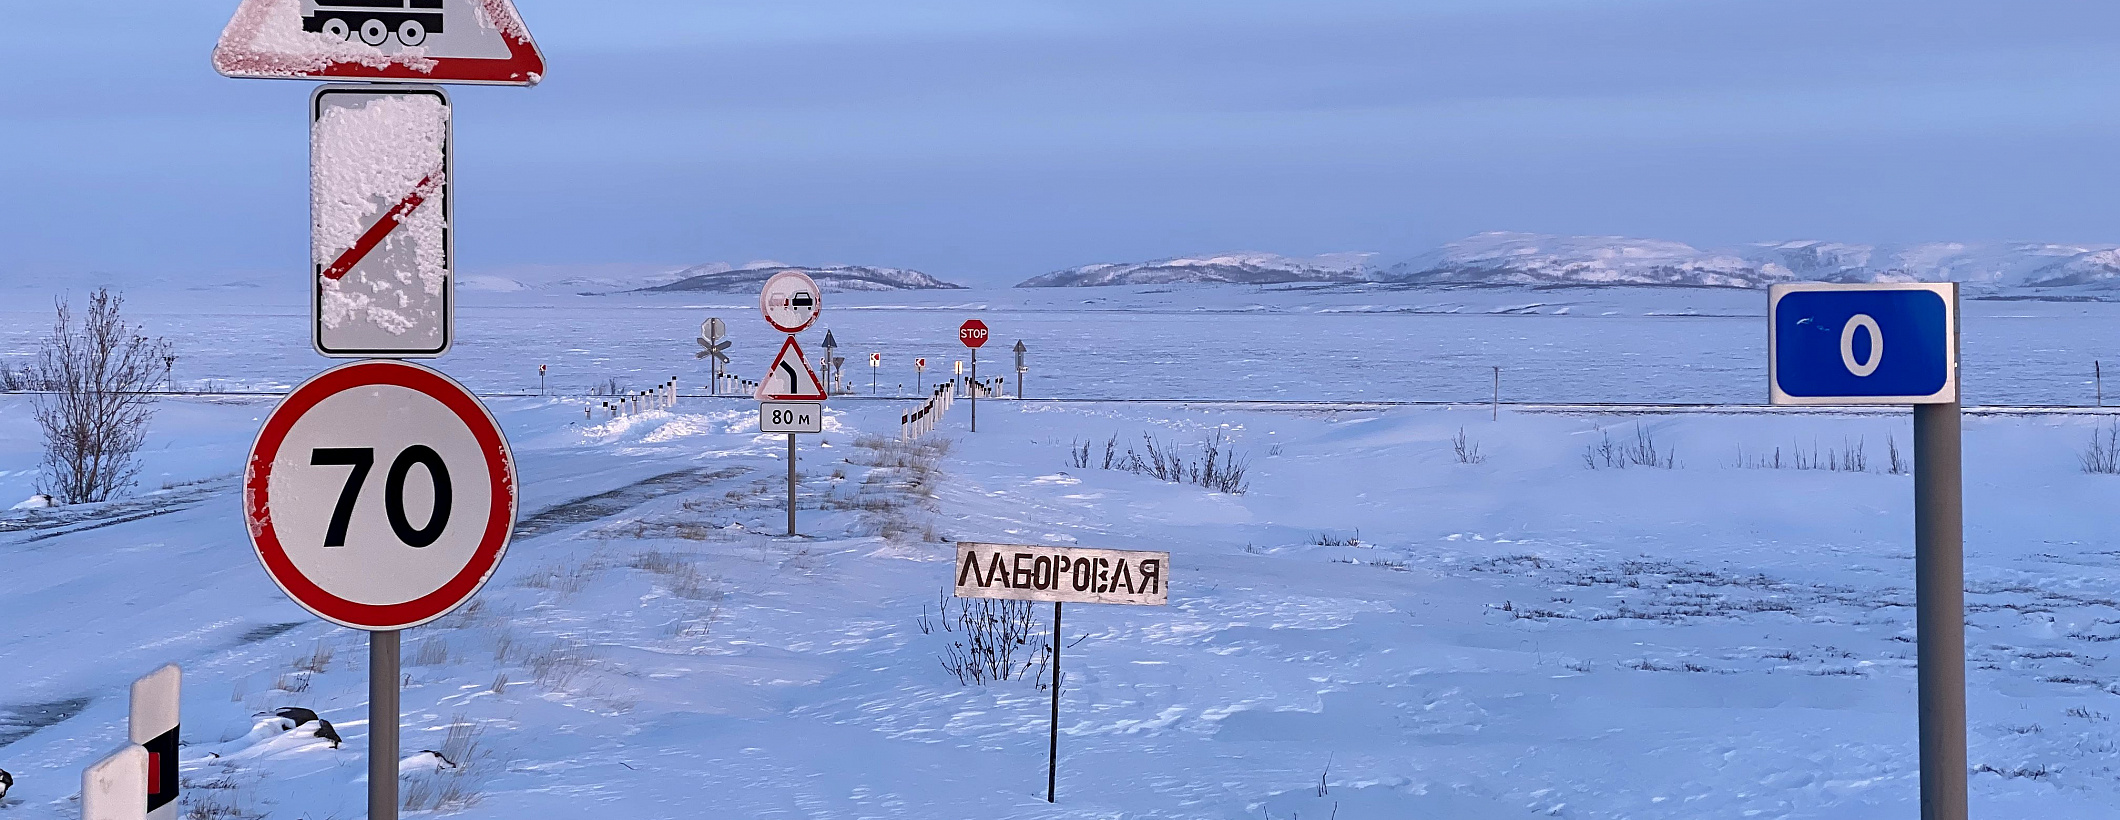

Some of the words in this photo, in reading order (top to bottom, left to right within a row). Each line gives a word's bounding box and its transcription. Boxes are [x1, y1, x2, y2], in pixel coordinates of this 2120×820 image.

[960, 328, 987, 339] STOP
[1840, 313, 1884, 377] 0
[772, 409, 794, 425] 80
[309, 444, 453, 548] 70
[957, 550, 1160, 595] ЛАБОРОВАЯ
